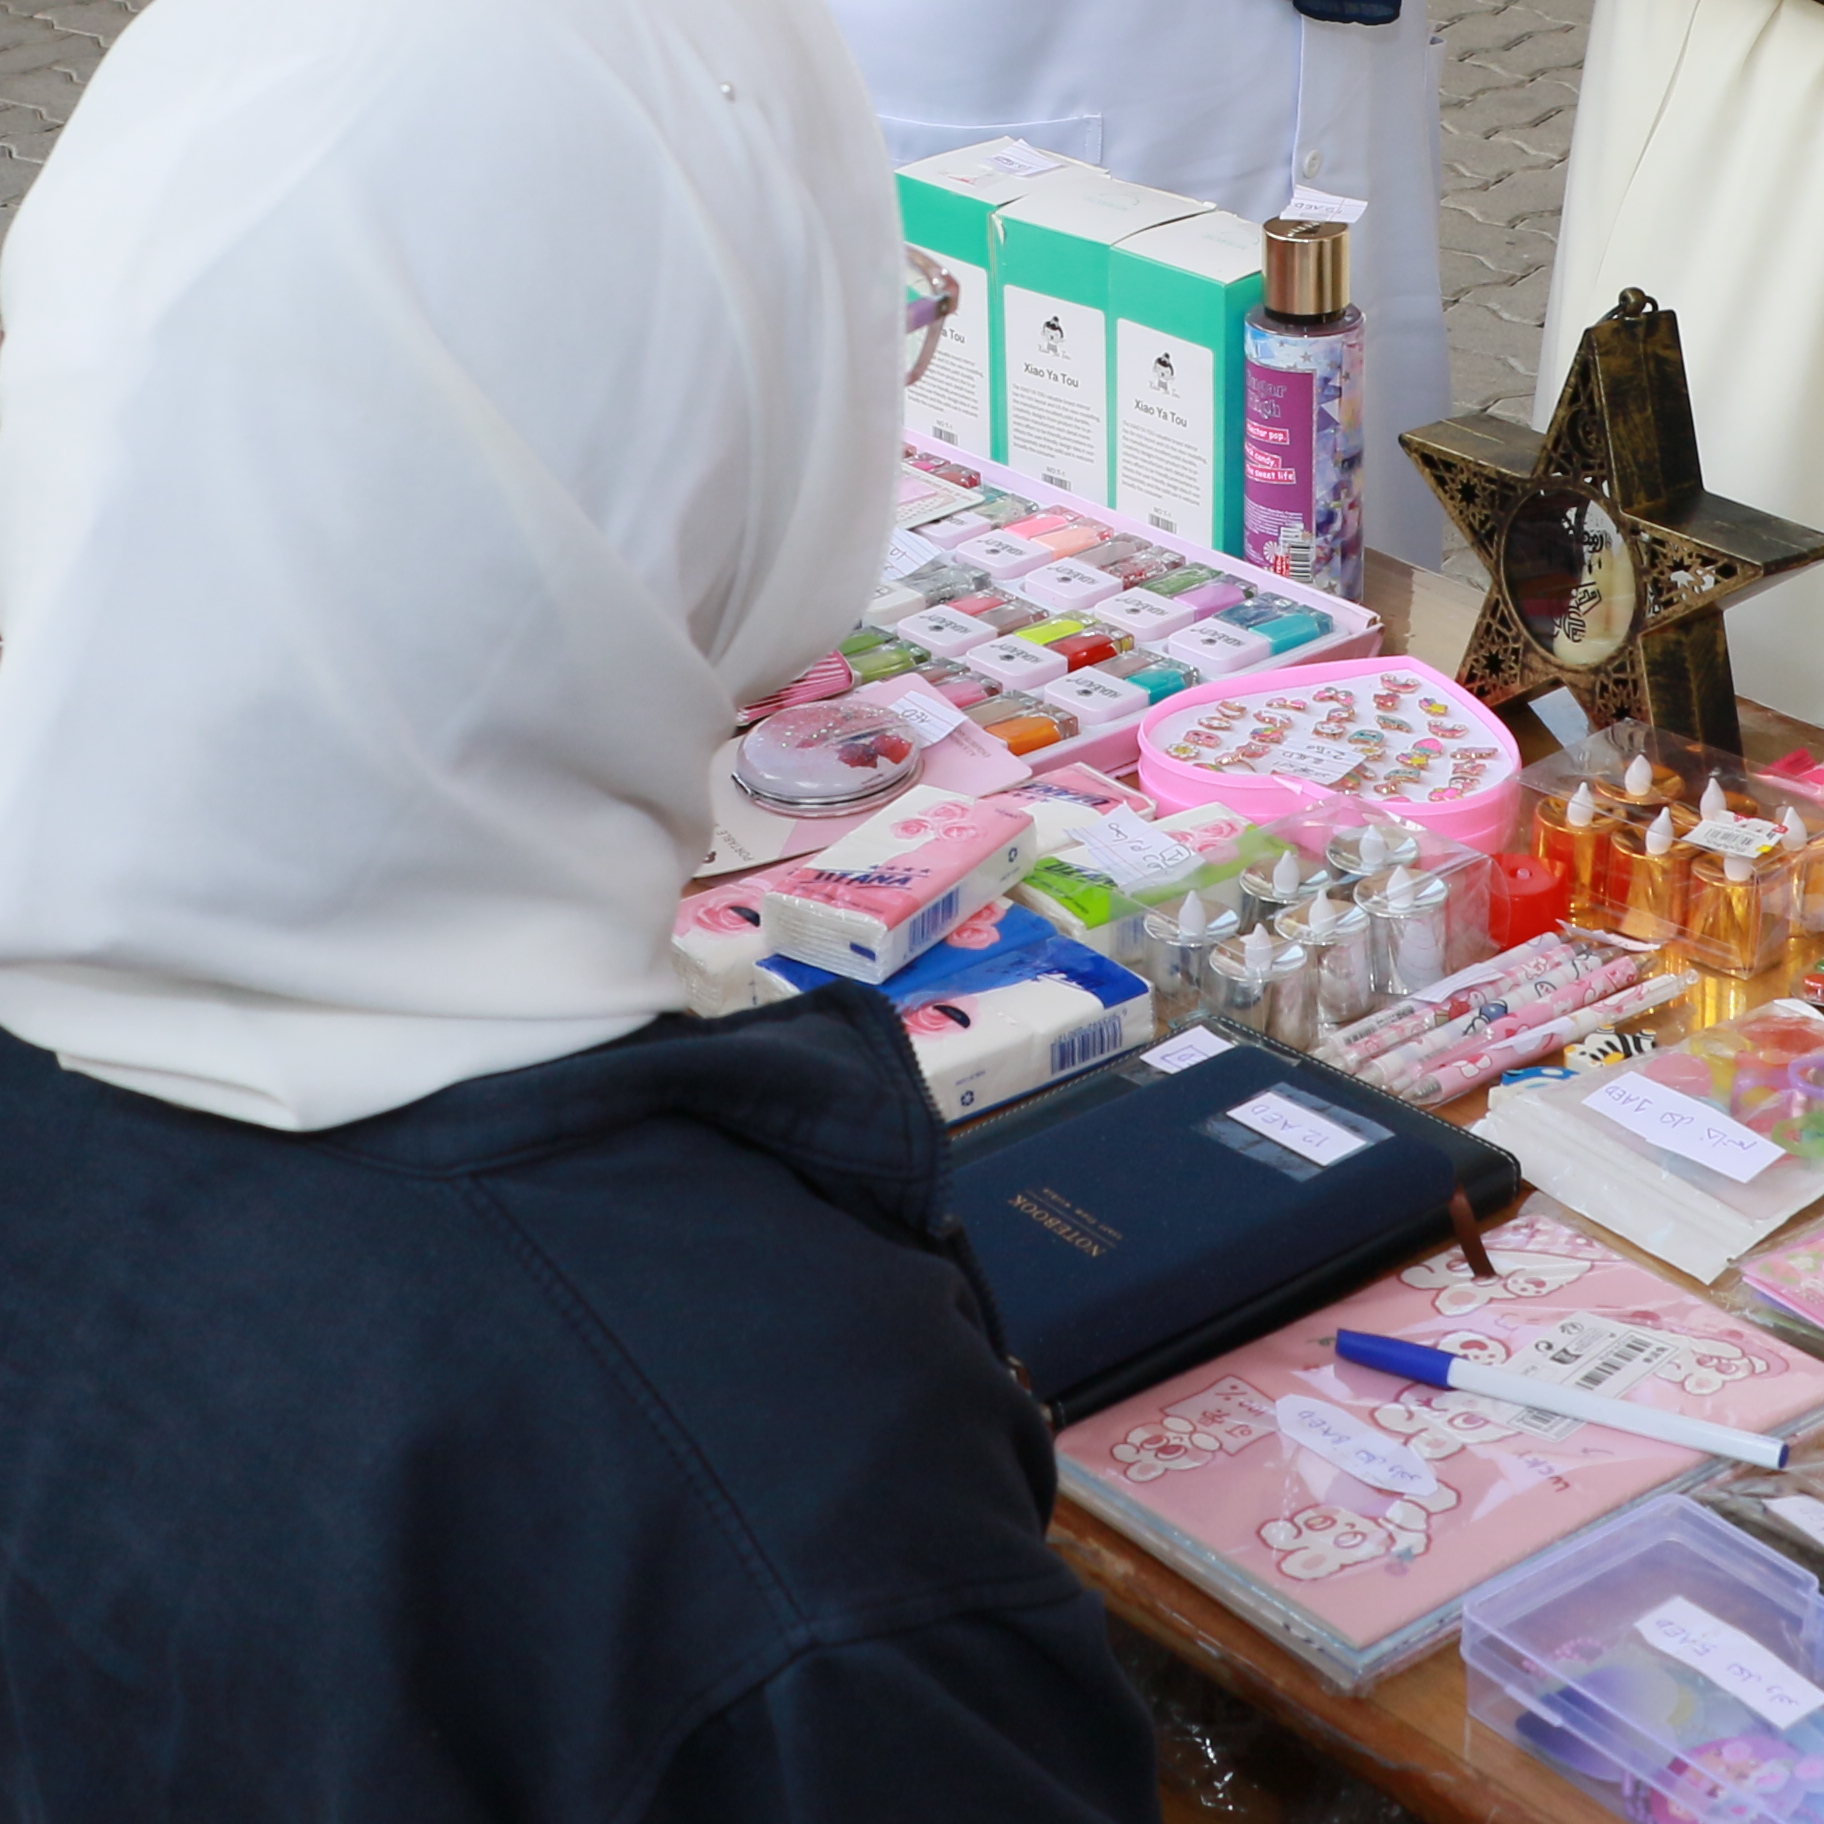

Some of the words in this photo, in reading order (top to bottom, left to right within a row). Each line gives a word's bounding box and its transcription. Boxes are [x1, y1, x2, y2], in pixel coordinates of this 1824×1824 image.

[1023, 362, 1045, 378] Xiao
[1046, 368, 1060, 382] Ya
[1061, 373, 1079, 388] Tou
[1134, 399, 1155, 415] Xiao
[1156, 406, 1168, 421] Ya
[1170, 411, 1188, 428] Tou
[1250, 1104, 1299, 1132] AED
[1007, 1193, 1107, 1258] NOTEBOOK
